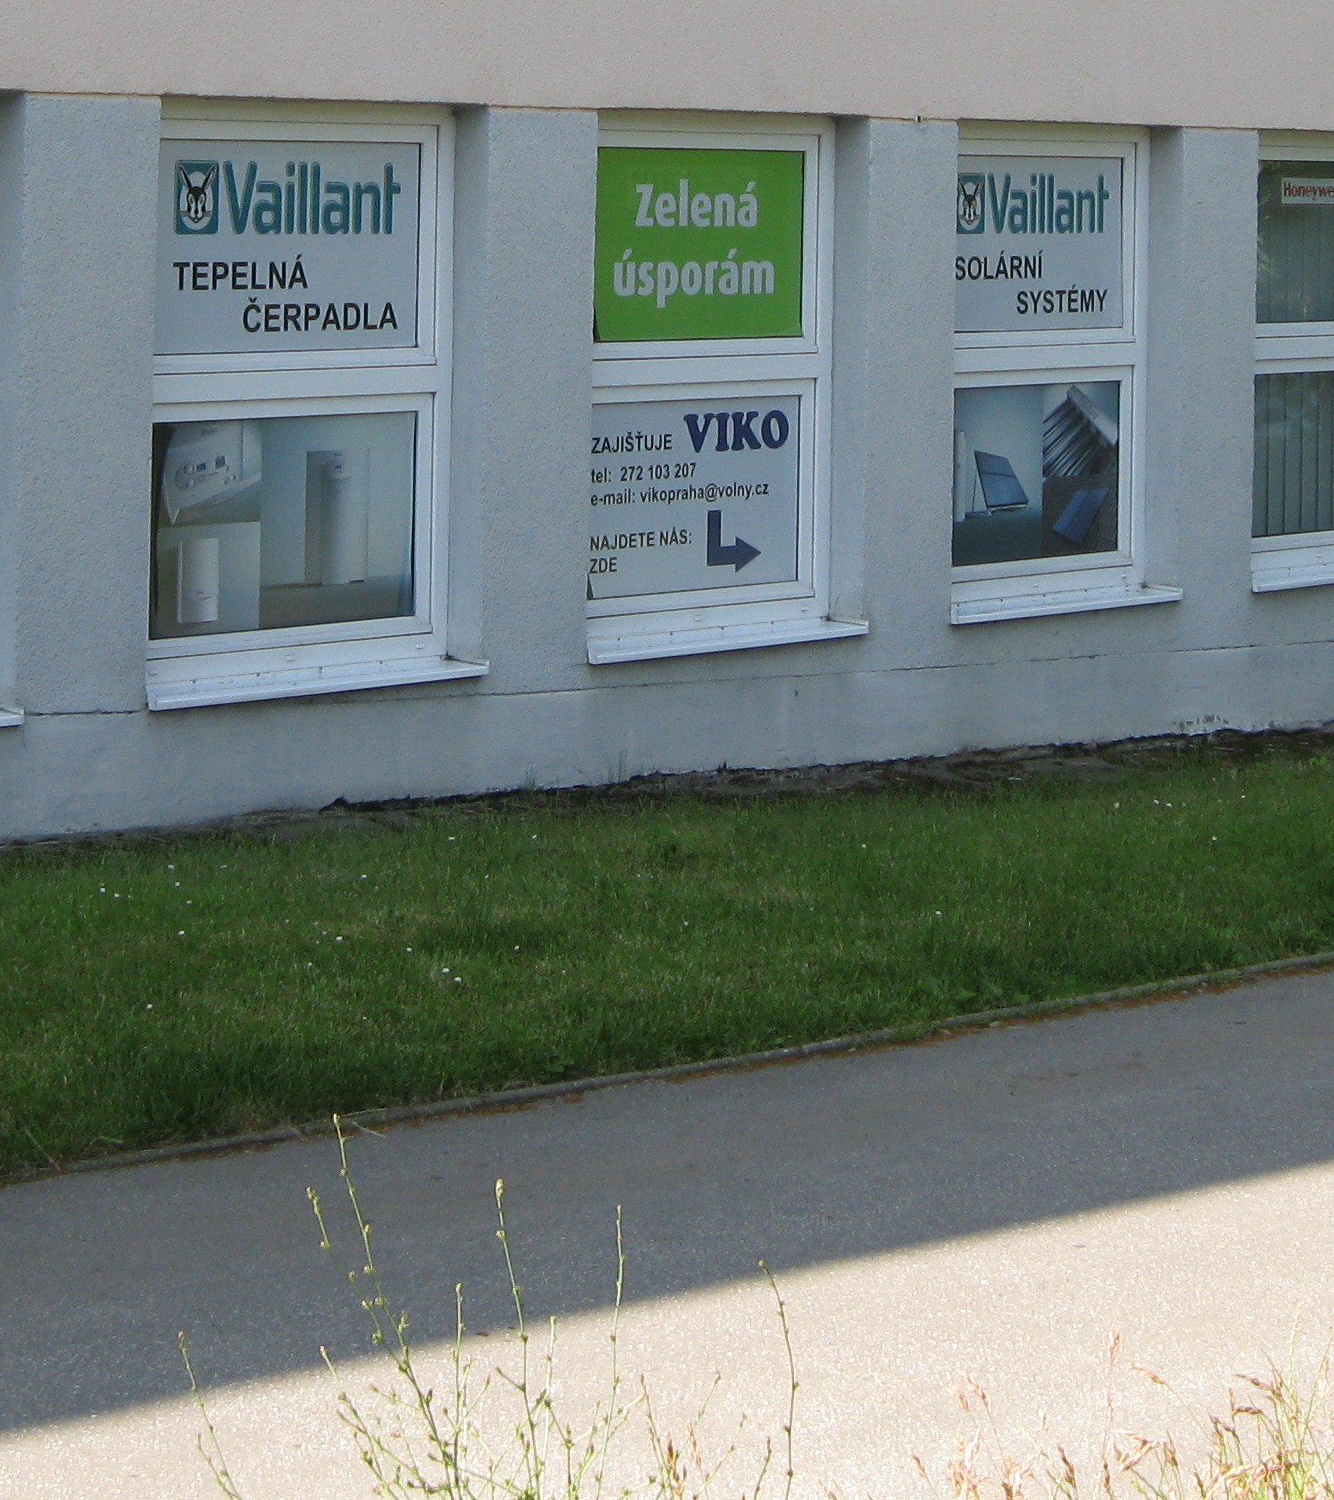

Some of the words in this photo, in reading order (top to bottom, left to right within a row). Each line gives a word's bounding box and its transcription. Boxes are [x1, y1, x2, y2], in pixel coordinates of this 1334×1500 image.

[222, 160, 402, 235] Vaillant
[635, 179, 758, 227] Zelená
[987, 172, 1110, 235] Vaillant
[172, 254, 308, 290] TEPELNÁ
[613, 248, 775, 309] úsporám
[955, 250, 1043, 280] SOLÁRNÍ
[242, 297, 398, 332] ČERPADLA
[1017, 284, 1108, 314] SYSTÉMY
[591, 431, 673, 454] ZAJIŠŤUJE
[683, 409, 789, 453] VIKO
[591, 468, 612, 484] tel:
[620, 466, 643, 482] 272
[648, 464, 670, 480] 103
[674, 462, 697, 478] 207
[590, 488, 635, 506] e-mail:
[640, 482, 769, 505] vikopraha@volny.cz
[590, 531, 655, 551] NAJDETE
[660, 527, 692, 546] NÁS:
[589, 557, 618, 574] ZDE
